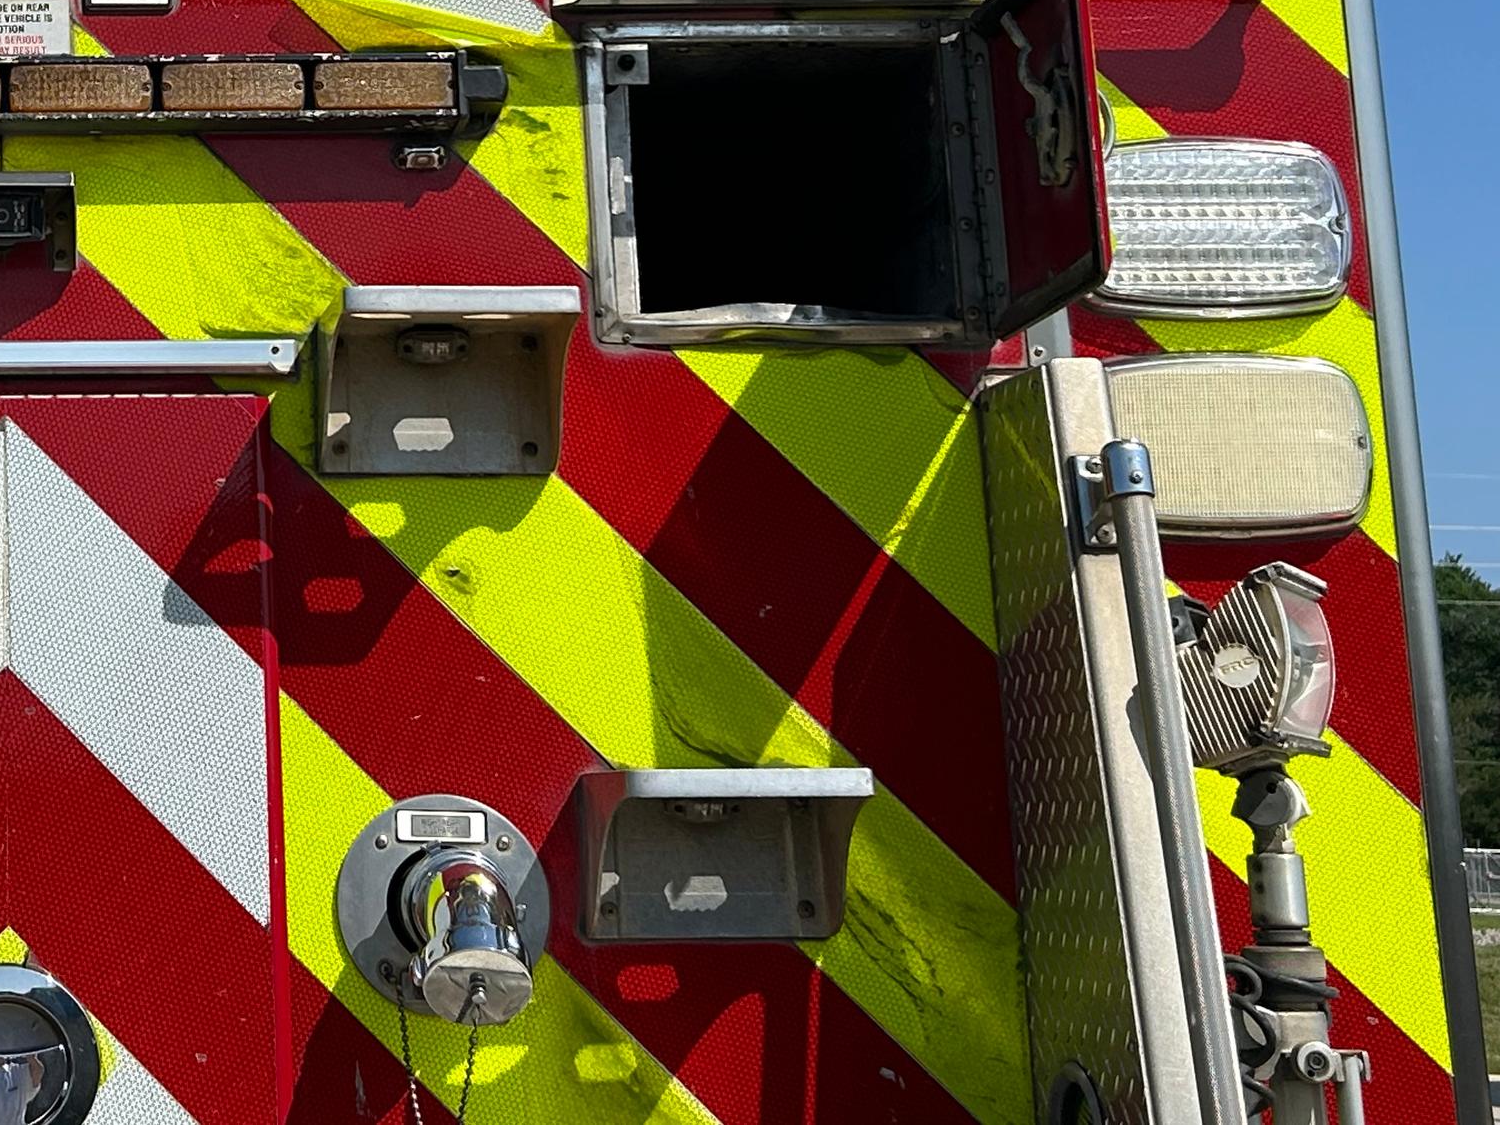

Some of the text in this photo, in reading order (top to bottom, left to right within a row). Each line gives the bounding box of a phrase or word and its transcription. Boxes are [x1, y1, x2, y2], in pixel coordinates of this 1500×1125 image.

[10, 4, 23, 13] ON
[26, 3, 50, 12] REAR
[4, 14, 41, 23] VEHICLE
[43, 14, 53, 22] IS
[4, 35, 44, 44] SERIOUS
[12, 46, 46, 55] RESULT
